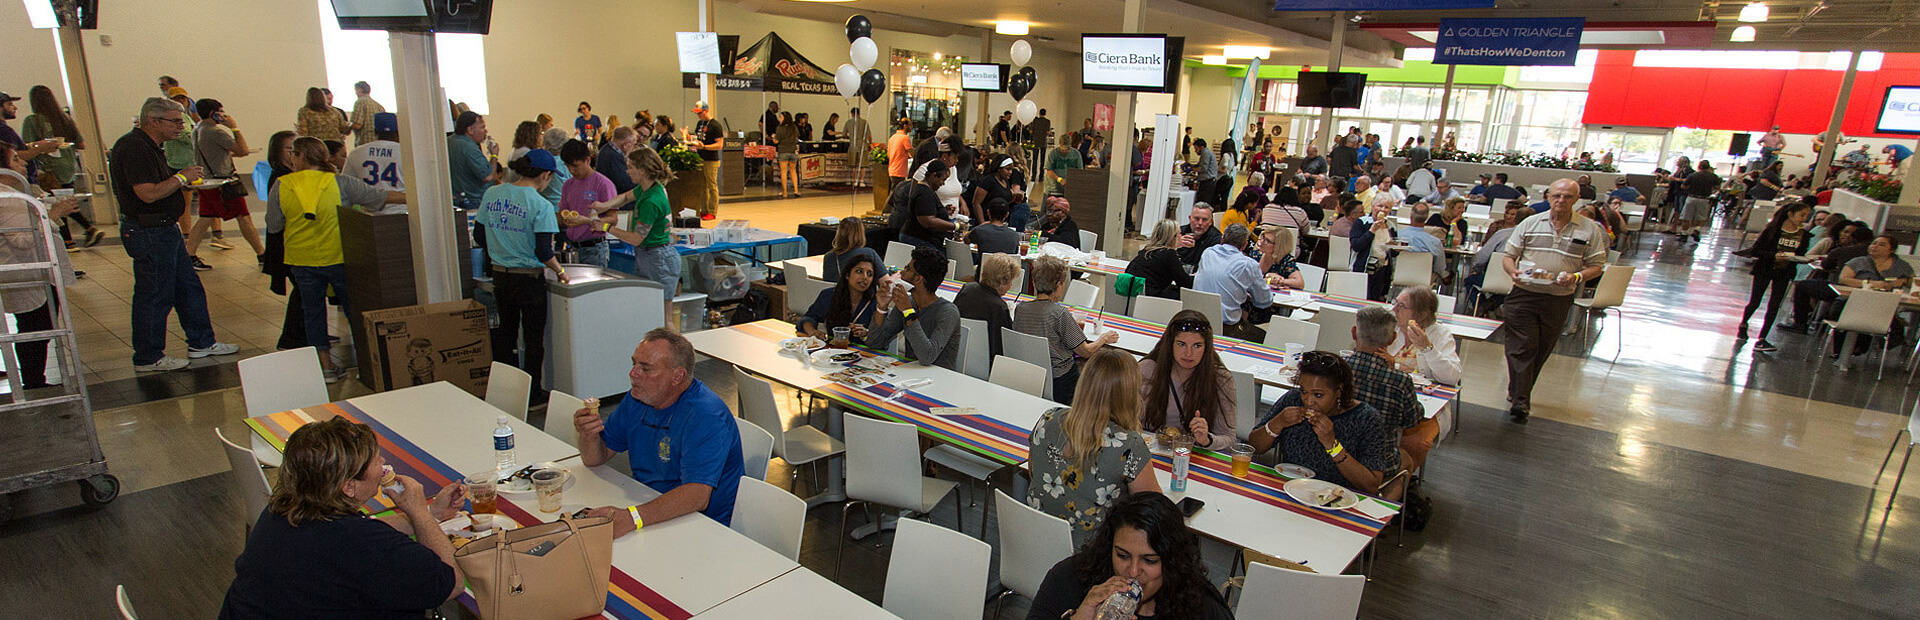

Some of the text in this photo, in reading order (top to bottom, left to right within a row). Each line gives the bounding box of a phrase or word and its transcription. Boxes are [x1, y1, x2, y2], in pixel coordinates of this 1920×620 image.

[1458, 27, 1575, 38] GOLDEN TRIANGLE
[1444, 46, 1566, 58] #ThatsHowWeDenton
[1098, 52, 1161, 65] Ciera Bank
[782, 81, 800, 91] REAL
[802, 82, 822, 92] TEXAS
[369, 147, 392, 157] RYAN
[362, 160, 399, 187] 34
[1778, 238, 1800, 248] UEEN
